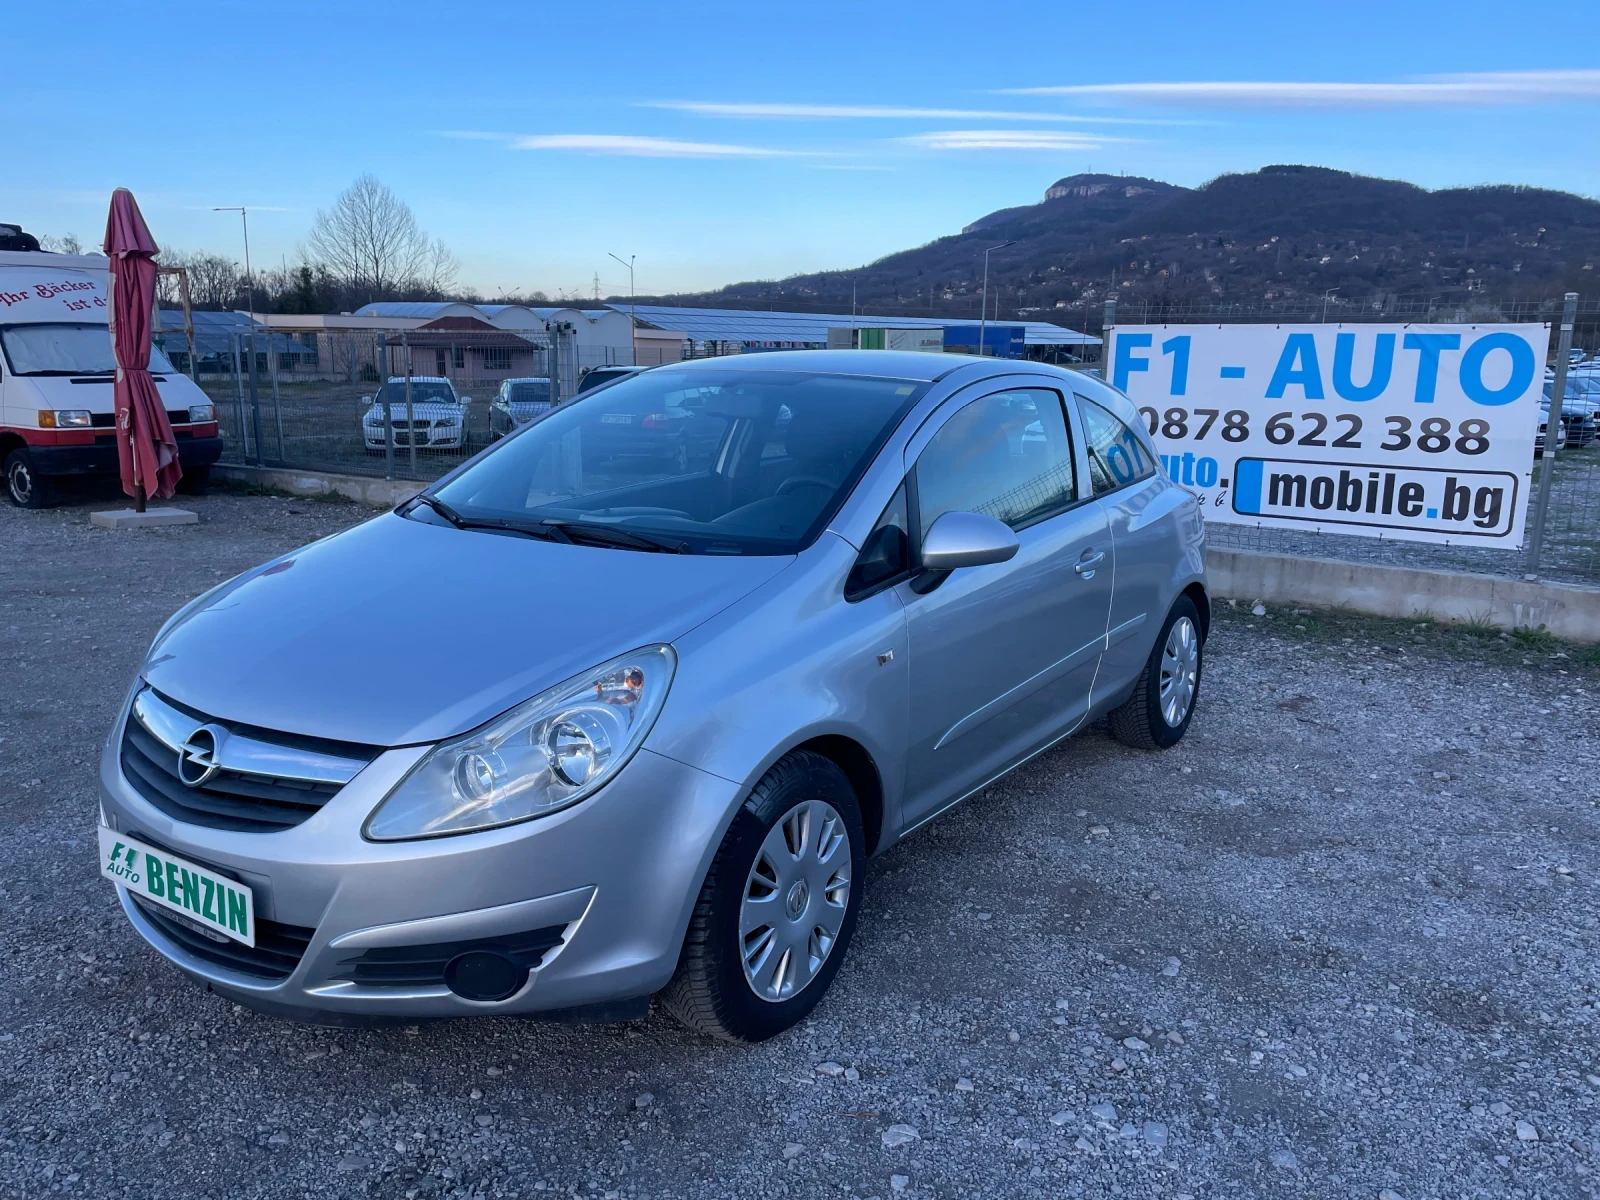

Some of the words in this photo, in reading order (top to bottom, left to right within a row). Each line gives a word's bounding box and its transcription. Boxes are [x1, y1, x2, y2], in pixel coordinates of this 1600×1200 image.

[33, 281, 96, 298] Bäcker
[63, 299, 91, 311] ist
[93, 296, 107, 307] d
[1113, 332, 1191, 396] F1
[1264, 332, 1535, 406] AUTO
[1138, 406, 1249, 443] 0878
[1264, 411, 1362, 449] 622
[1380, 415, 1490, 456] 388
[1268, 471, 1504, 528] mobile.bg
[106, 862, 140, 884] AUTO
[145, 852, 248, 938] BENZIN
